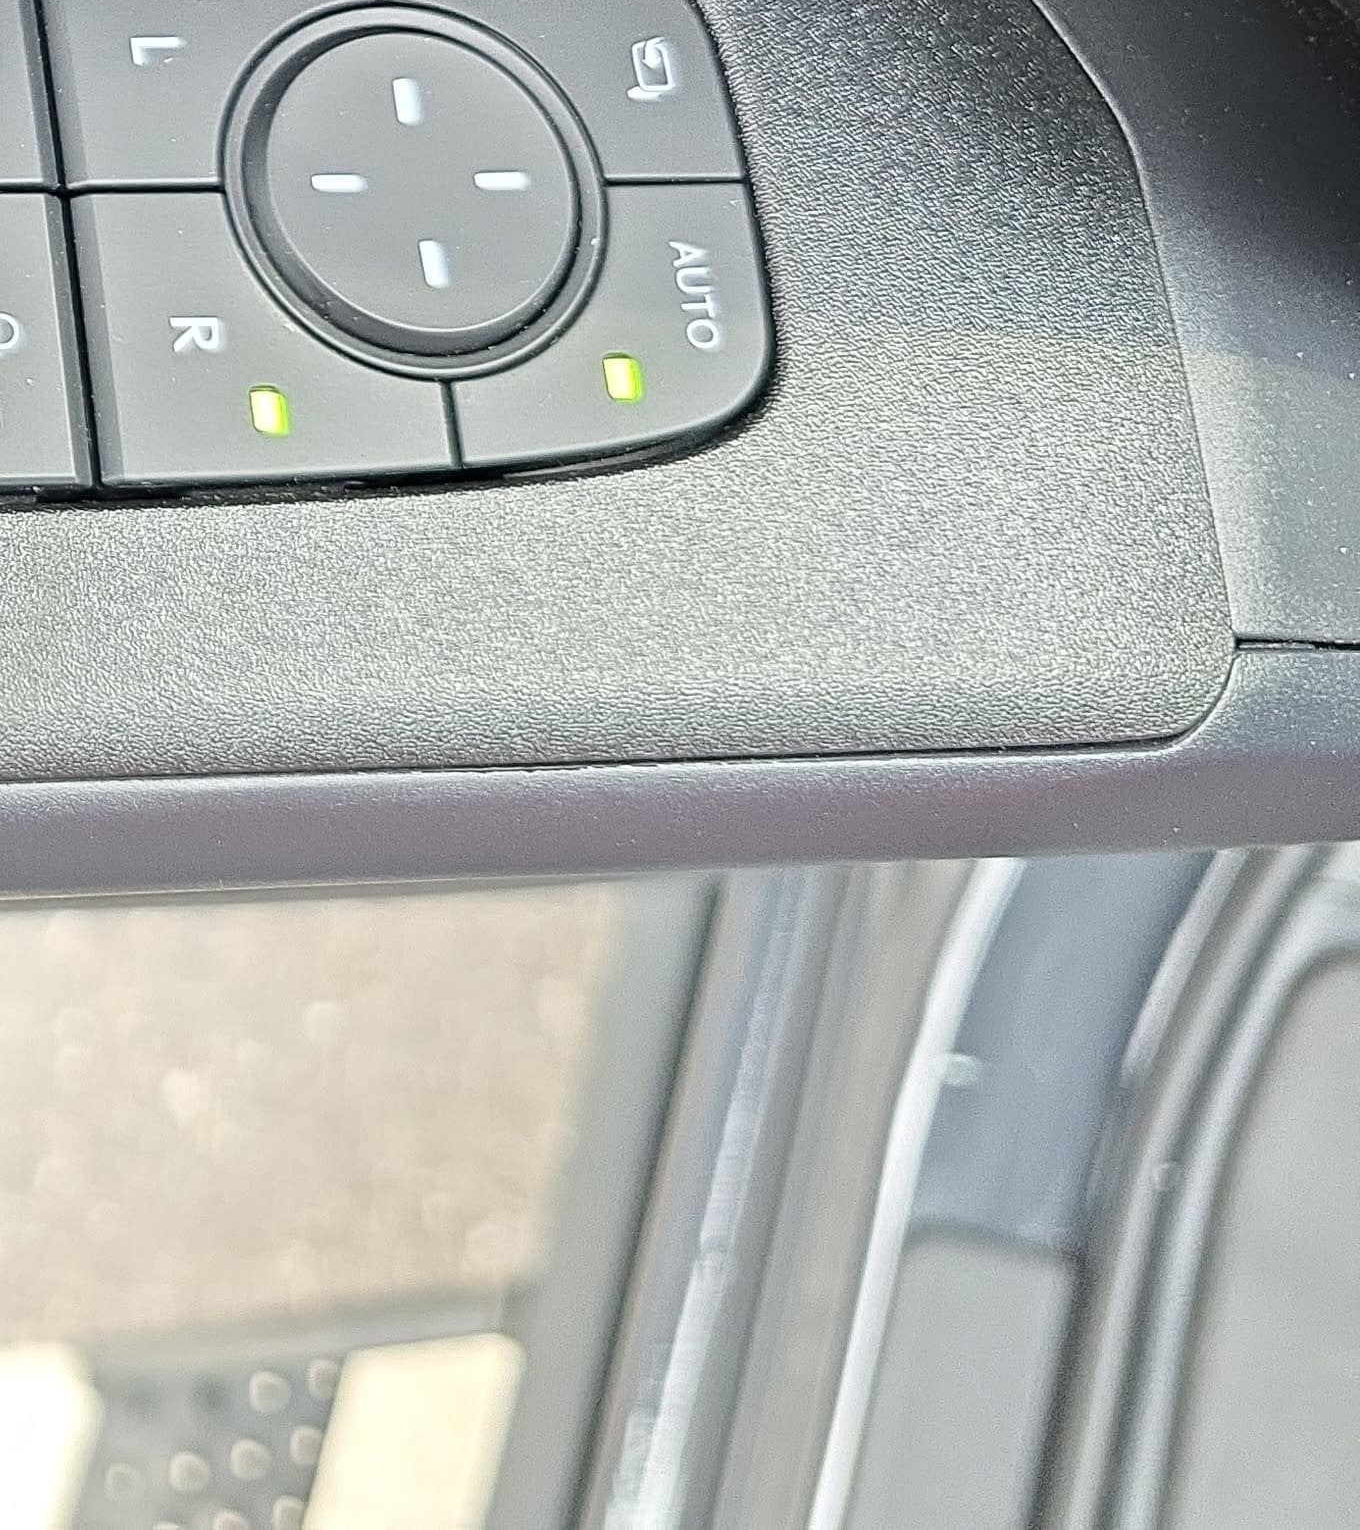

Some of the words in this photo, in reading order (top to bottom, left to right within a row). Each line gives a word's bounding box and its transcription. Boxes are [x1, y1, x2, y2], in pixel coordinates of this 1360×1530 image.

[129, 36, 187, 67] L
[668, 240, 720, 350] AUTO
[169, 316, 224, 353] R
